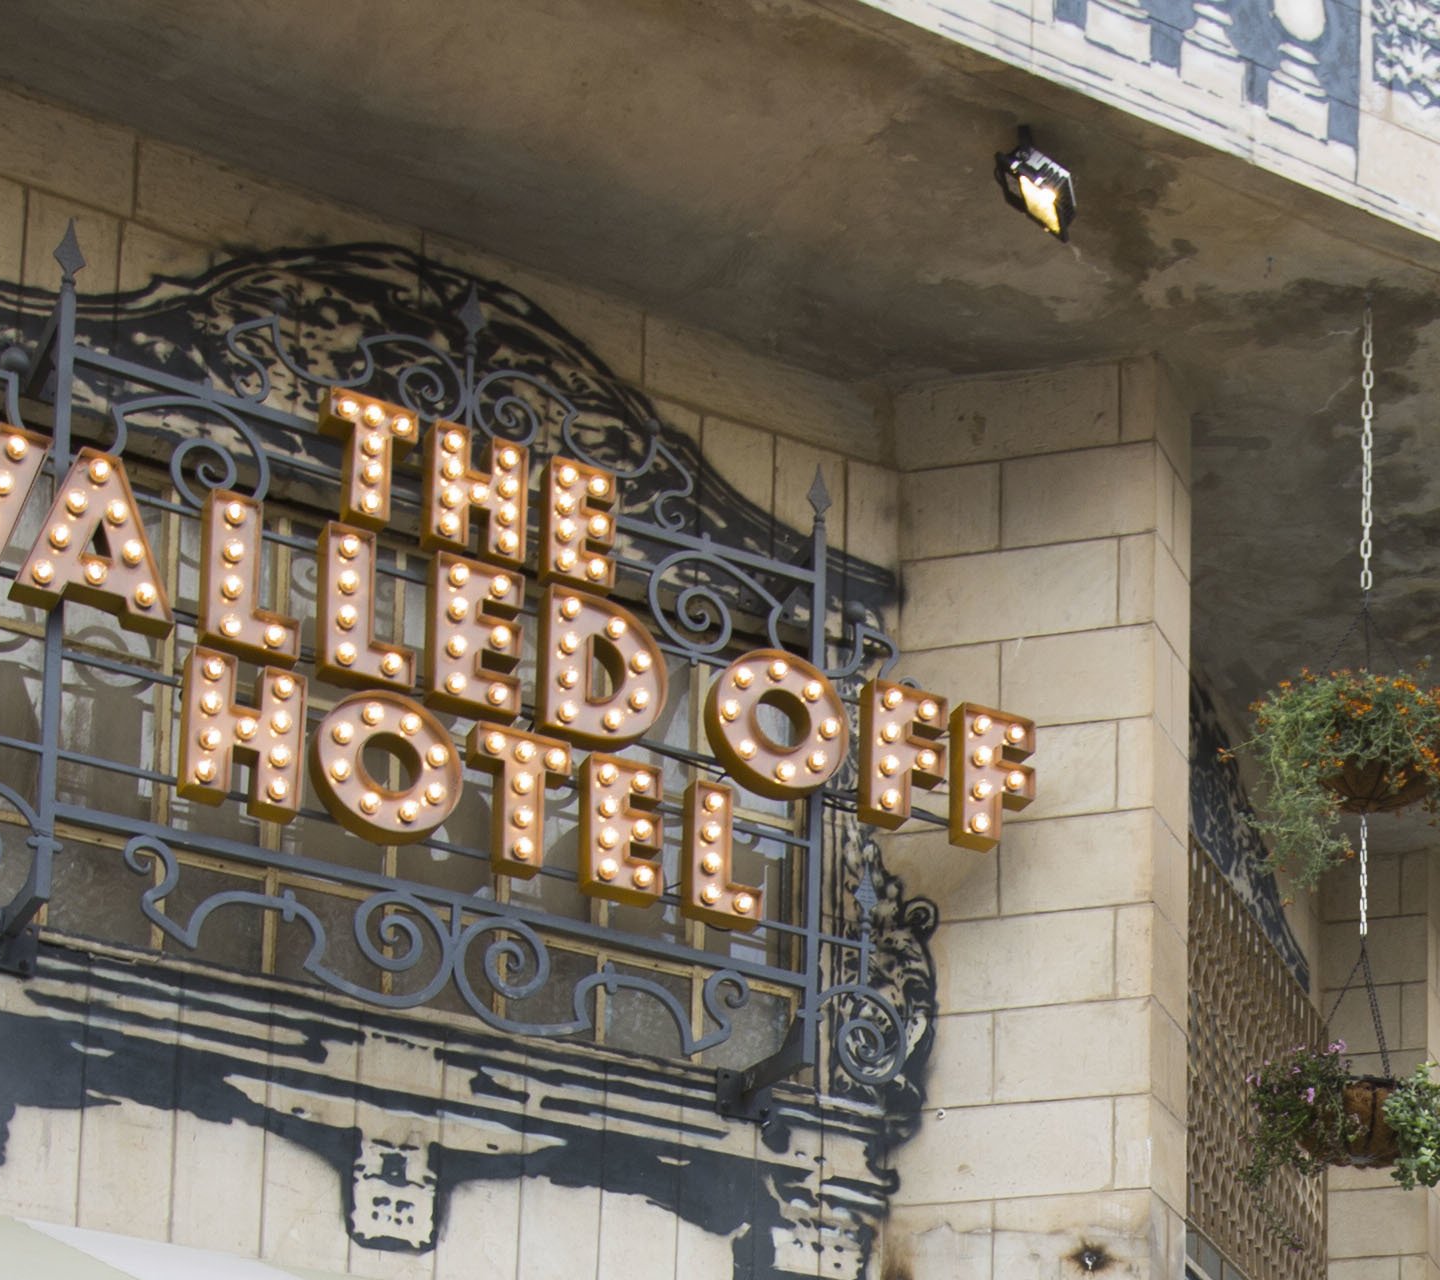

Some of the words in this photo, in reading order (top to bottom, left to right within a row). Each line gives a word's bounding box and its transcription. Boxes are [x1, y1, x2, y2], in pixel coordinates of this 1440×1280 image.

[318, 387, 618, 591] THE
[176, 644, 763, 932] HOTEL
[704, 647, 1037, 853] OFF
